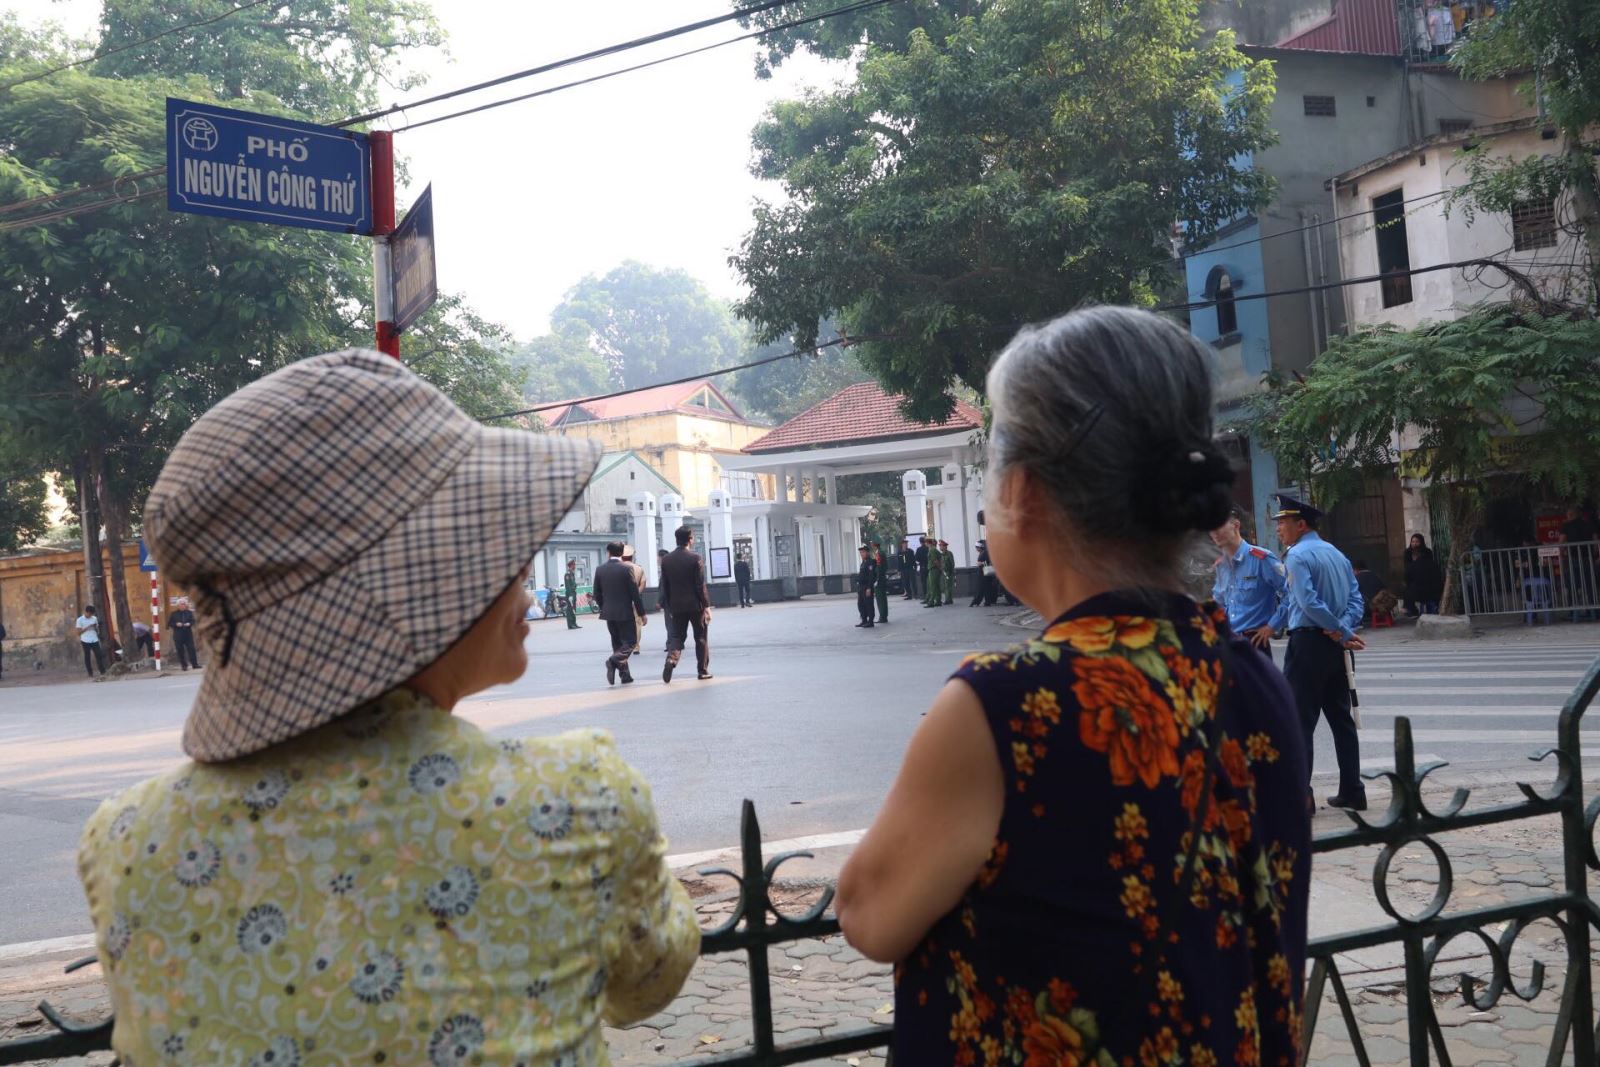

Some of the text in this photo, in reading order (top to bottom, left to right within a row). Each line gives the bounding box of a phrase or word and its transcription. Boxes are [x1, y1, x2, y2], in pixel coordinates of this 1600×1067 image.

[247, 136, 309, 162] PHỐ
[184, 153, 357, 215] NGUYỄN CÔNG TRỨ
